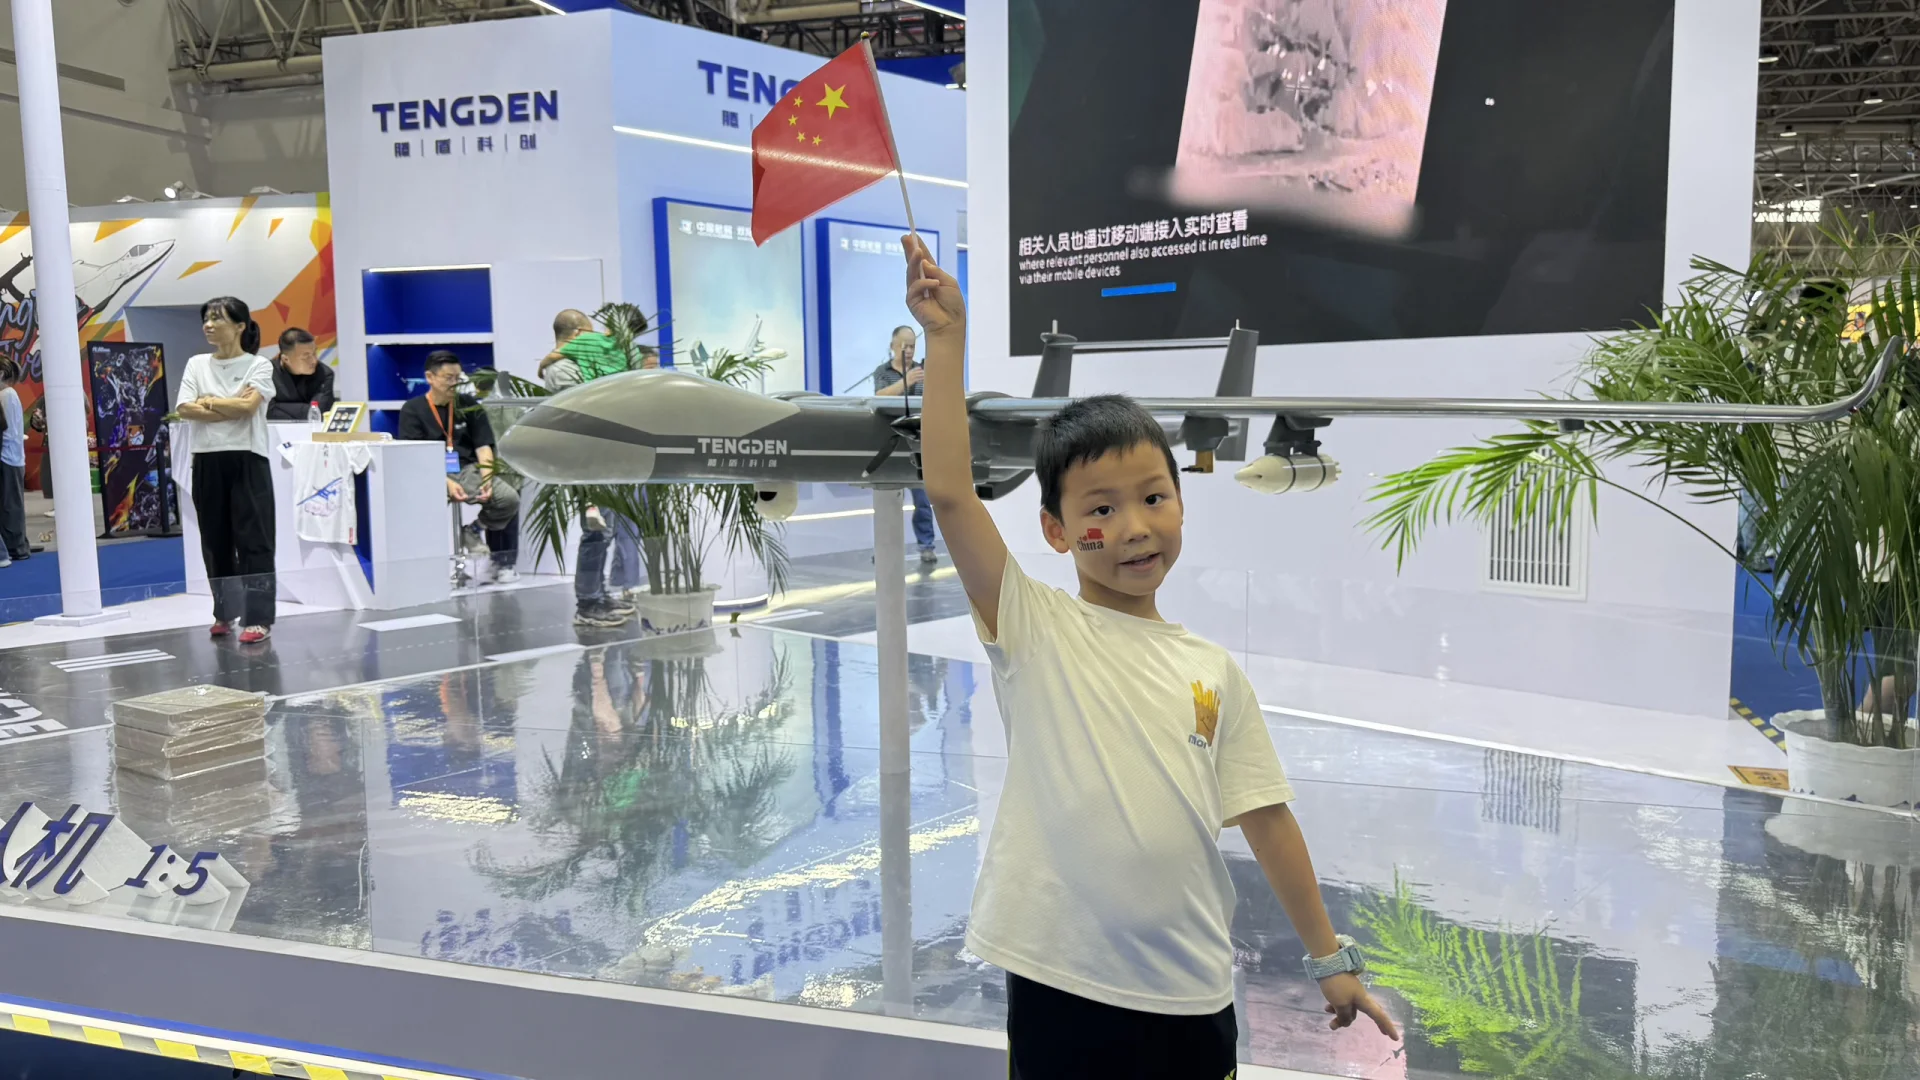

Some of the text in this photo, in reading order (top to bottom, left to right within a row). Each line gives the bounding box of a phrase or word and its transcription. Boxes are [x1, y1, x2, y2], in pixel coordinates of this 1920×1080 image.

[372, 90, 558, 132] TENGDEN
[1019, 208, 1248, 256] 相关人员也通过移动端接入实时查看
[1019, 233, 1268, 271] where relevant personnel also accessed it in real time
[1019, 264, 1121, 284] via their mobile devices
[697, 438, 787, 455] TENGDEN
[1076, 539, 1104, 551] China
[124, 844, 219, 896] 1:5
